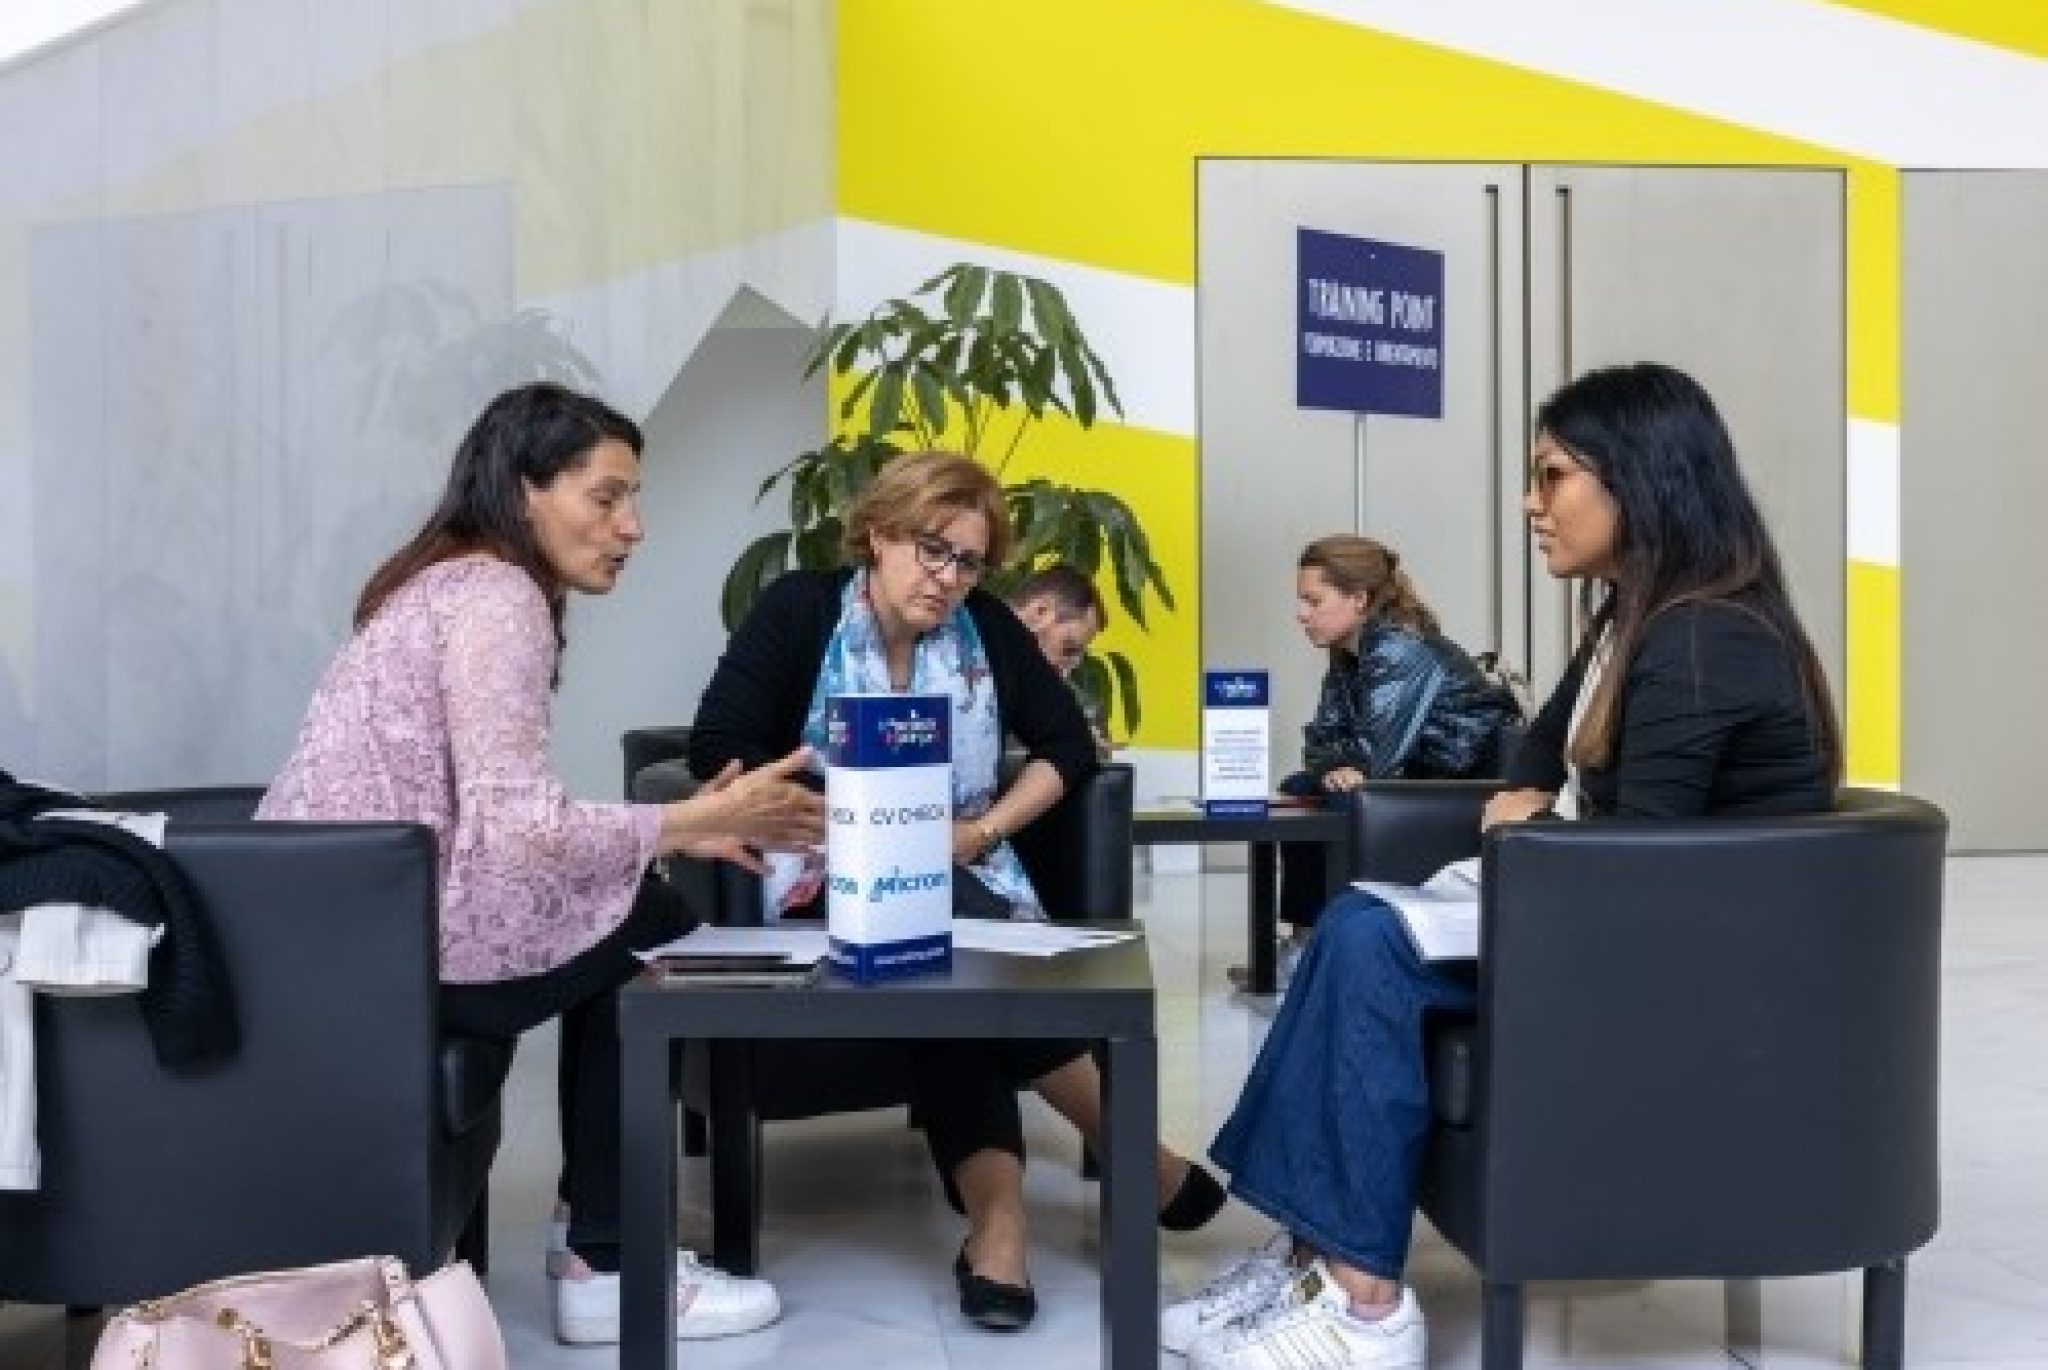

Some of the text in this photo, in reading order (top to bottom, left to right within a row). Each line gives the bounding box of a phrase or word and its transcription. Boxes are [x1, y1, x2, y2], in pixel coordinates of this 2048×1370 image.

[1308, 279, 1437, 331] TRAINING POINT
[869, 808, 896, 825] CV
